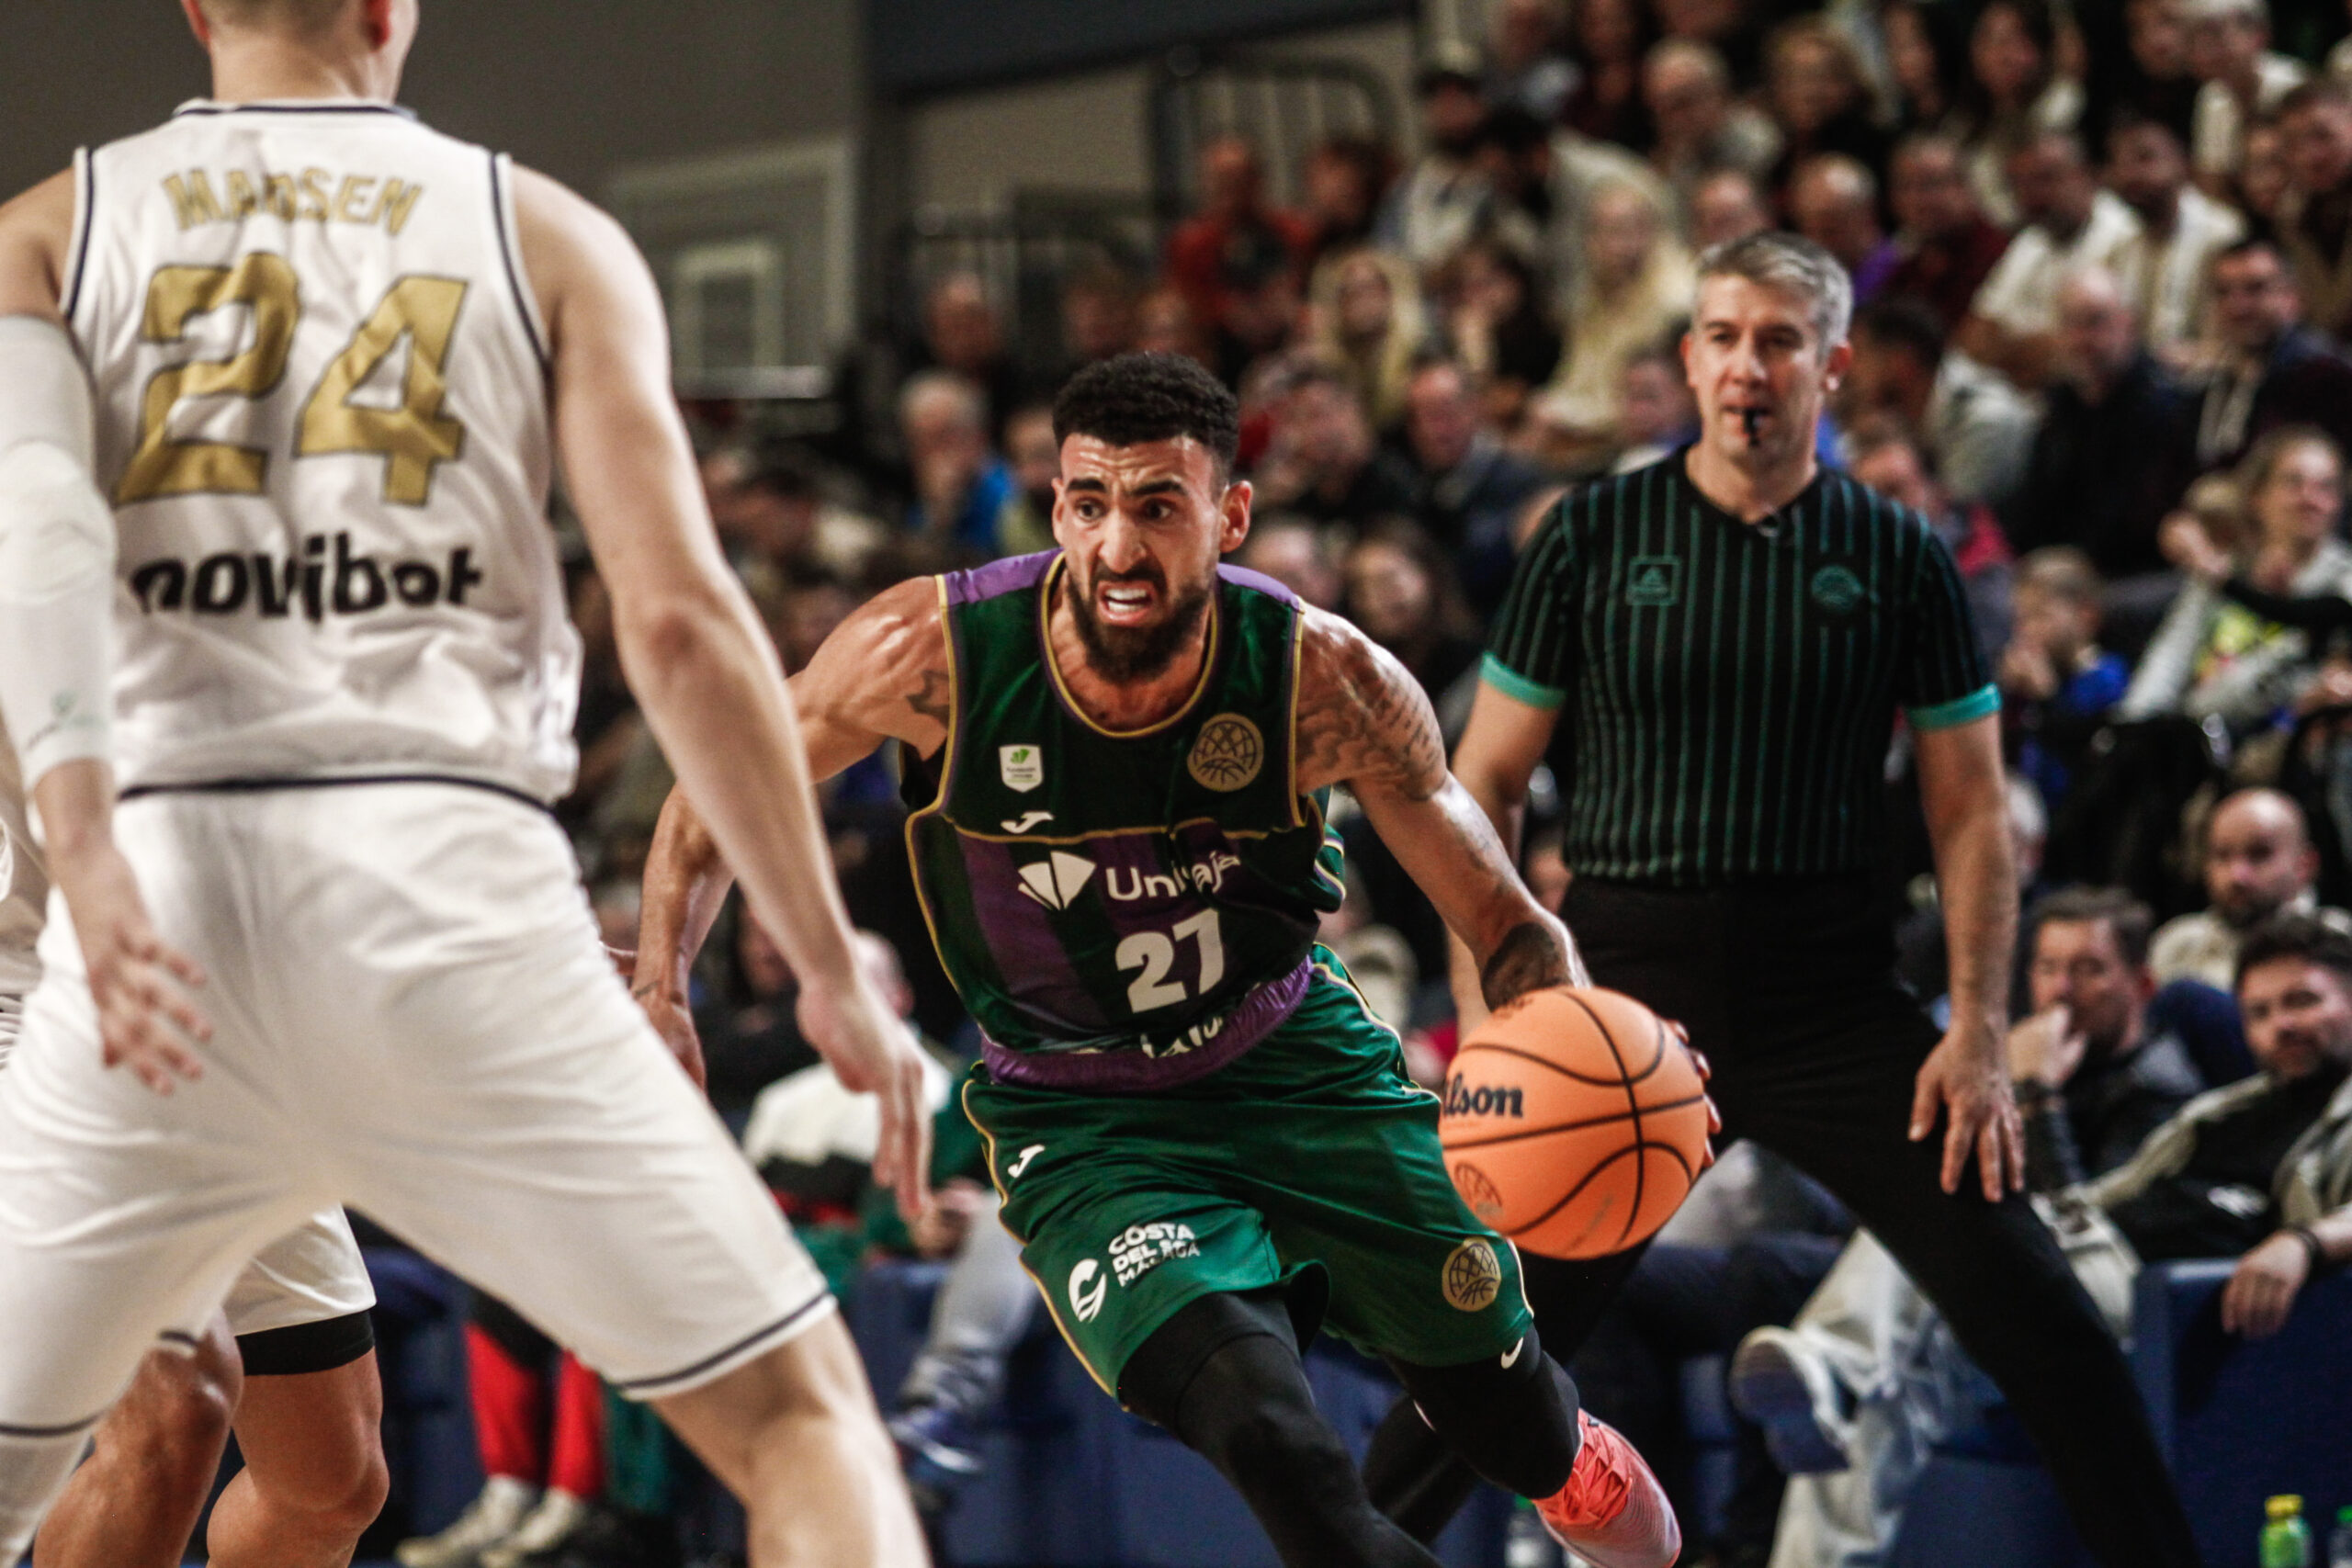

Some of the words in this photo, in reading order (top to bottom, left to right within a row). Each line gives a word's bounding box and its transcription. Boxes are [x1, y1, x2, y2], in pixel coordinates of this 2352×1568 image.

[113, 250, 470, 509] 24
[130, 531, 484, 626] novibot
[1105, 850, 1240, 901] Uniaja
[1114, 908, 1225, 1014] 27
[1443, 1071, 1523, 1118] lson
[1108, 1222, 1195, 1256] COSTA
[1112, 1242, 1159, 1274] DEL
